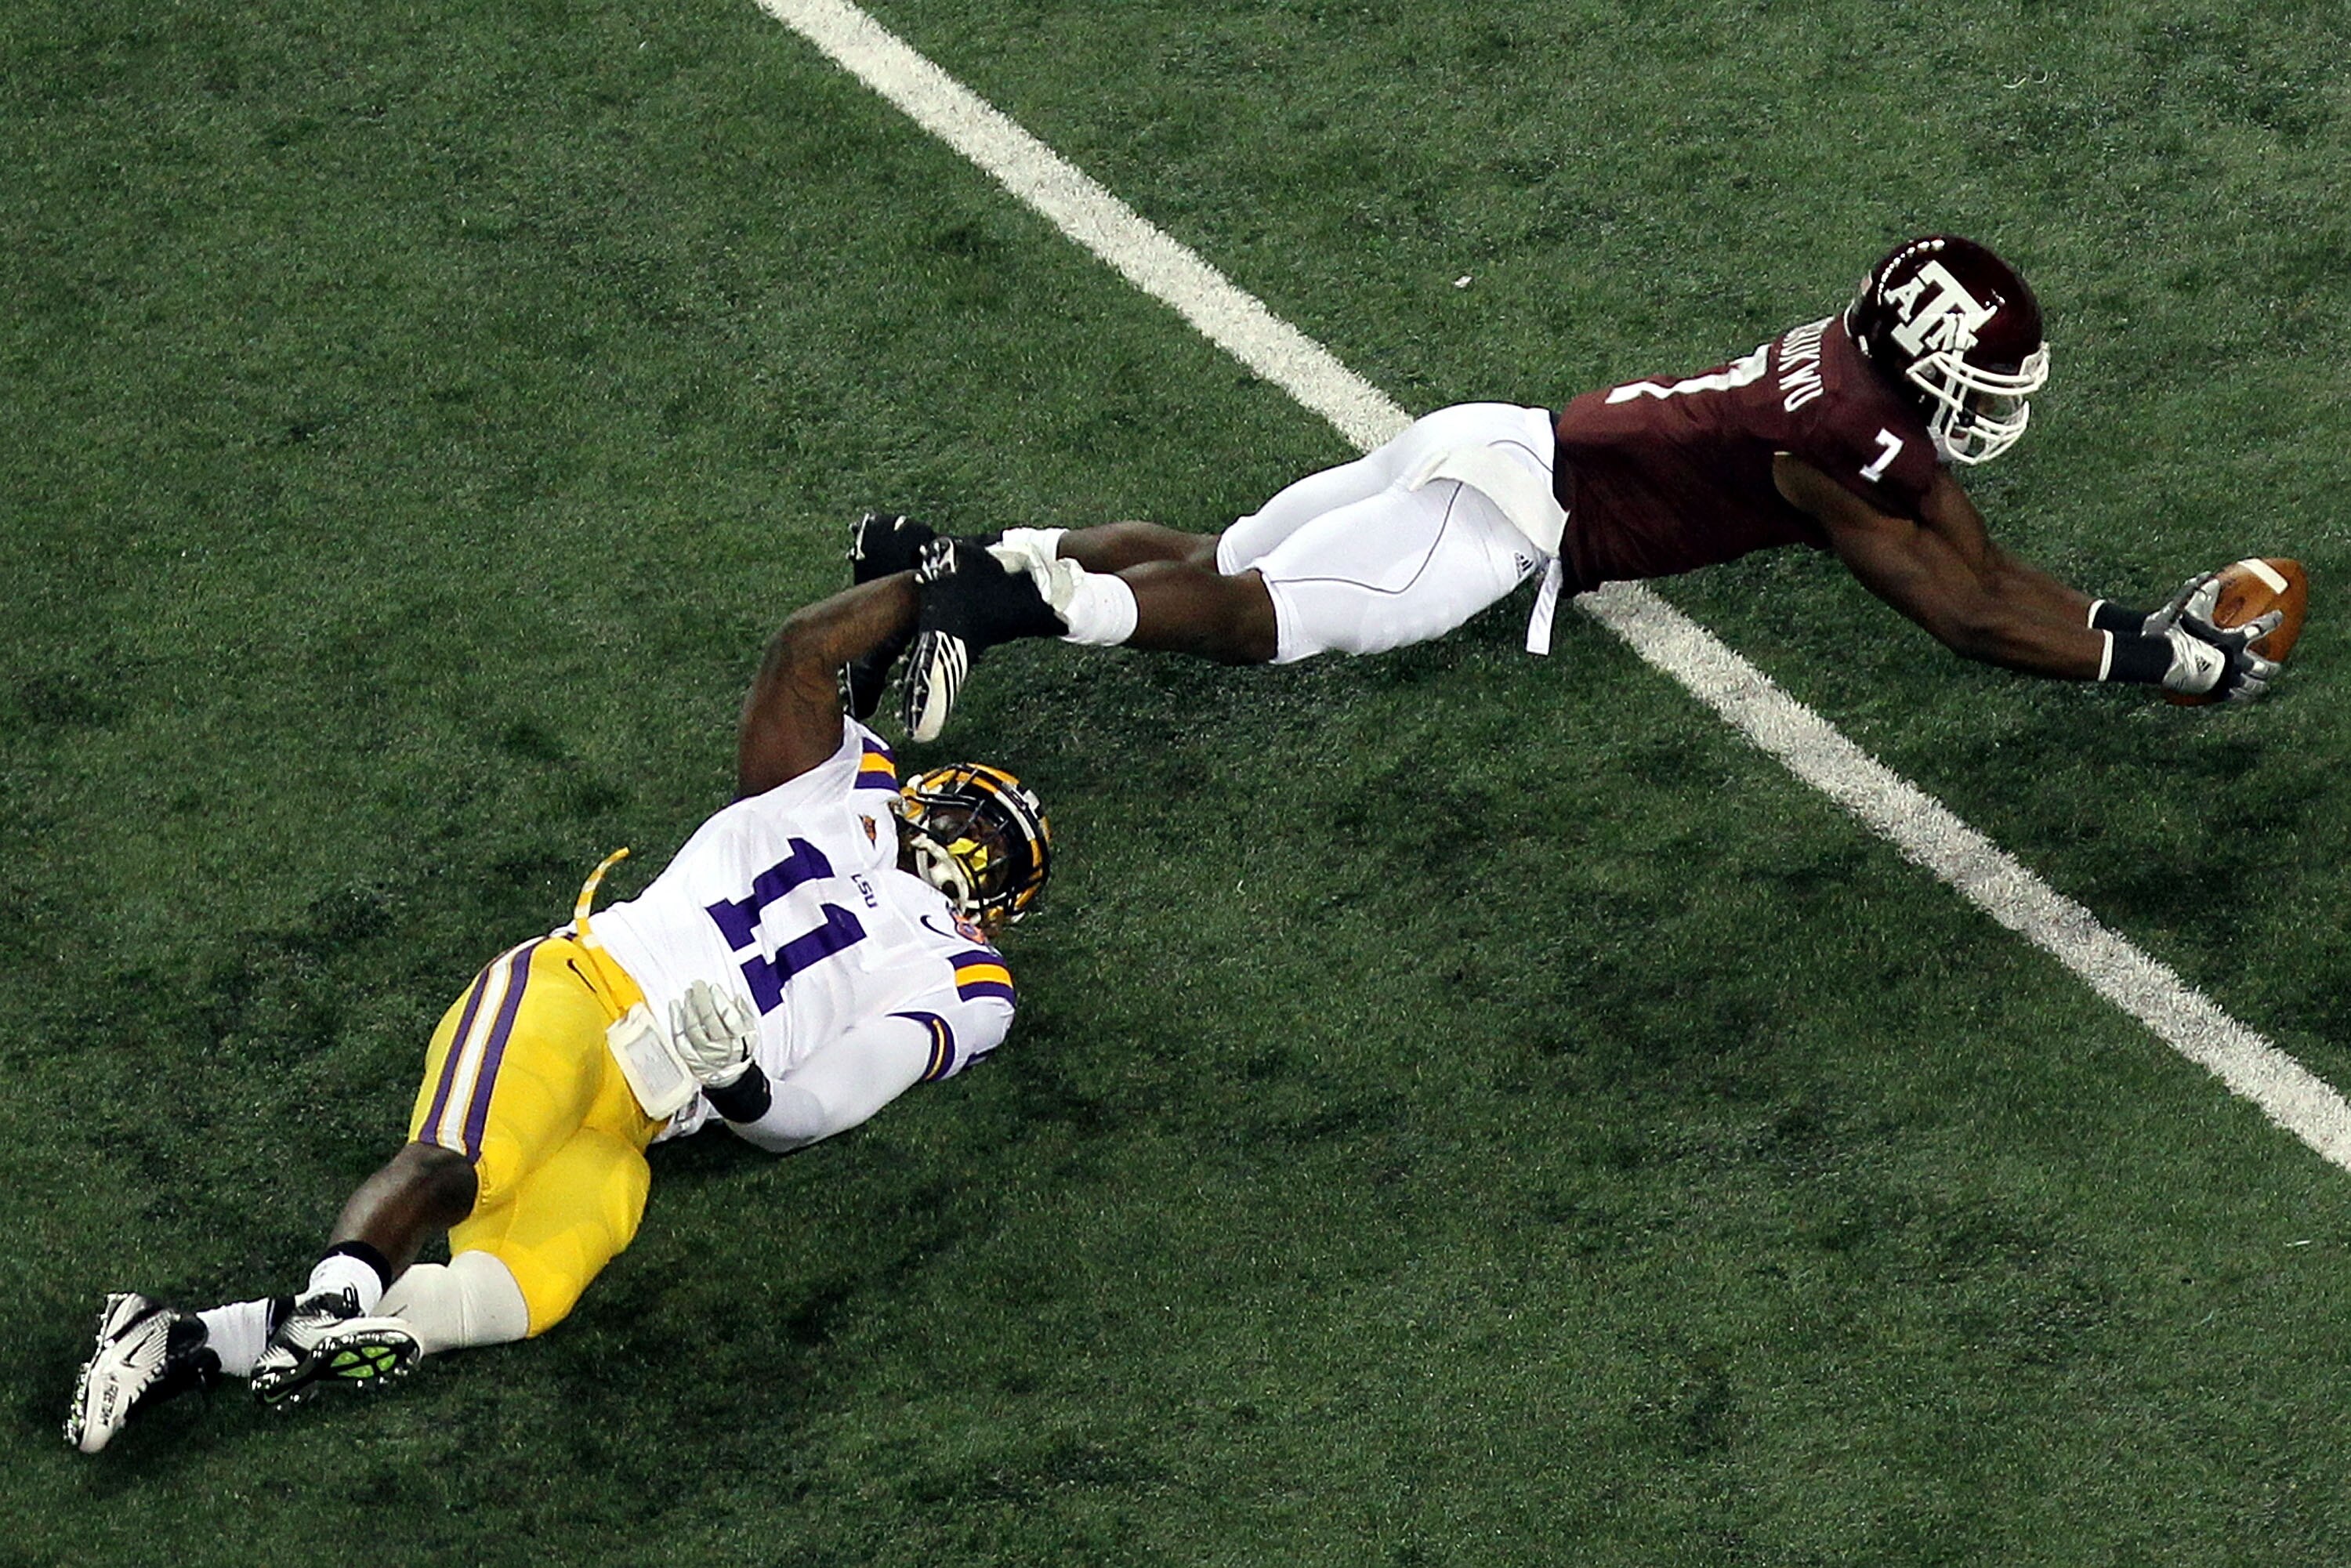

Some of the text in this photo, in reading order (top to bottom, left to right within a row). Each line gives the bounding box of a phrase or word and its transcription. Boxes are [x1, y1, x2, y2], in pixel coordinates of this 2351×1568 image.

[1860, 429, 1903, 483] 7
[850, 873, 878, 909] LSU
[705, 837, 868, 1017] 11
